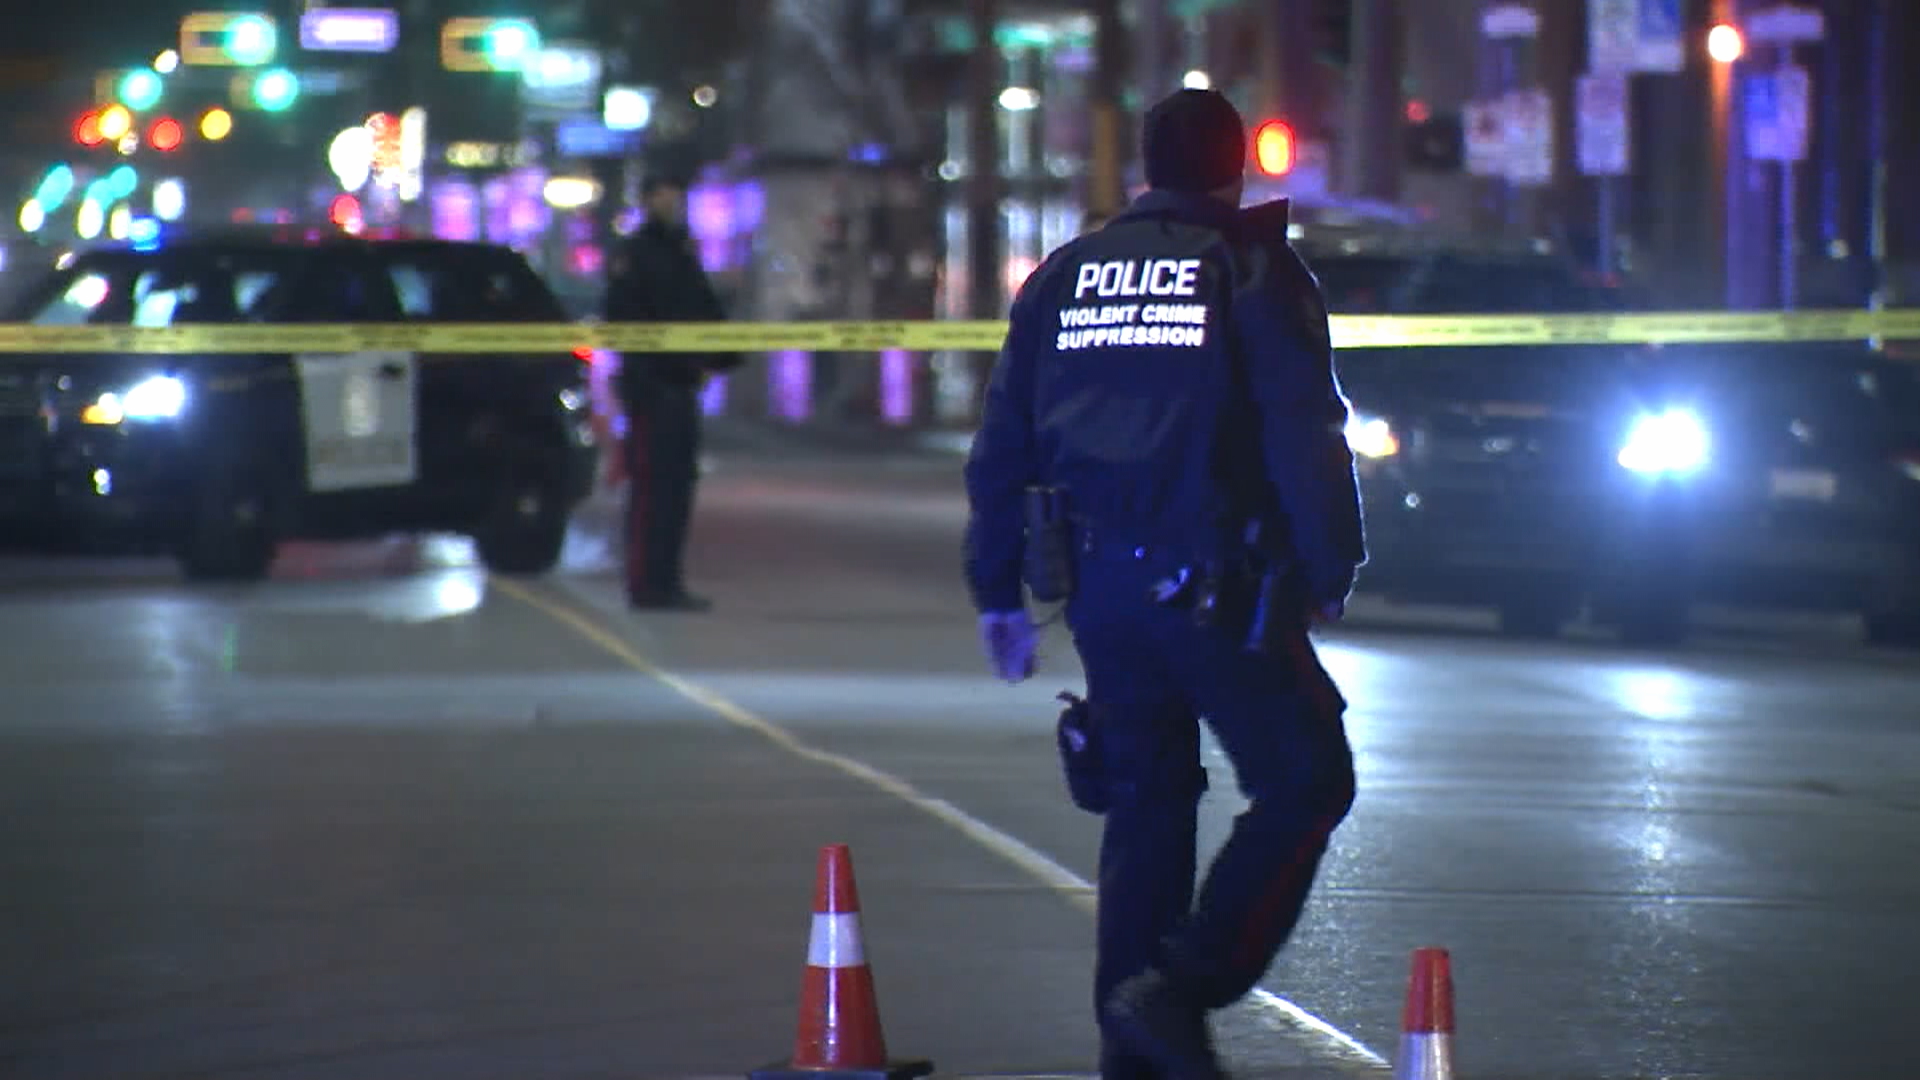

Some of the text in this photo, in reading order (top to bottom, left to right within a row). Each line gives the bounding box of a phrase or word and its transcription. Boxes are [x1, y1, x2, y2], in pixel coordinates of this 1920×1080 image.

[1075, 260, 1200, 298] POLICE
[1059, 304, 1206, 327] VIOLENT CRIME
[1056, 327, 1205, 350] SUPPRESSION
